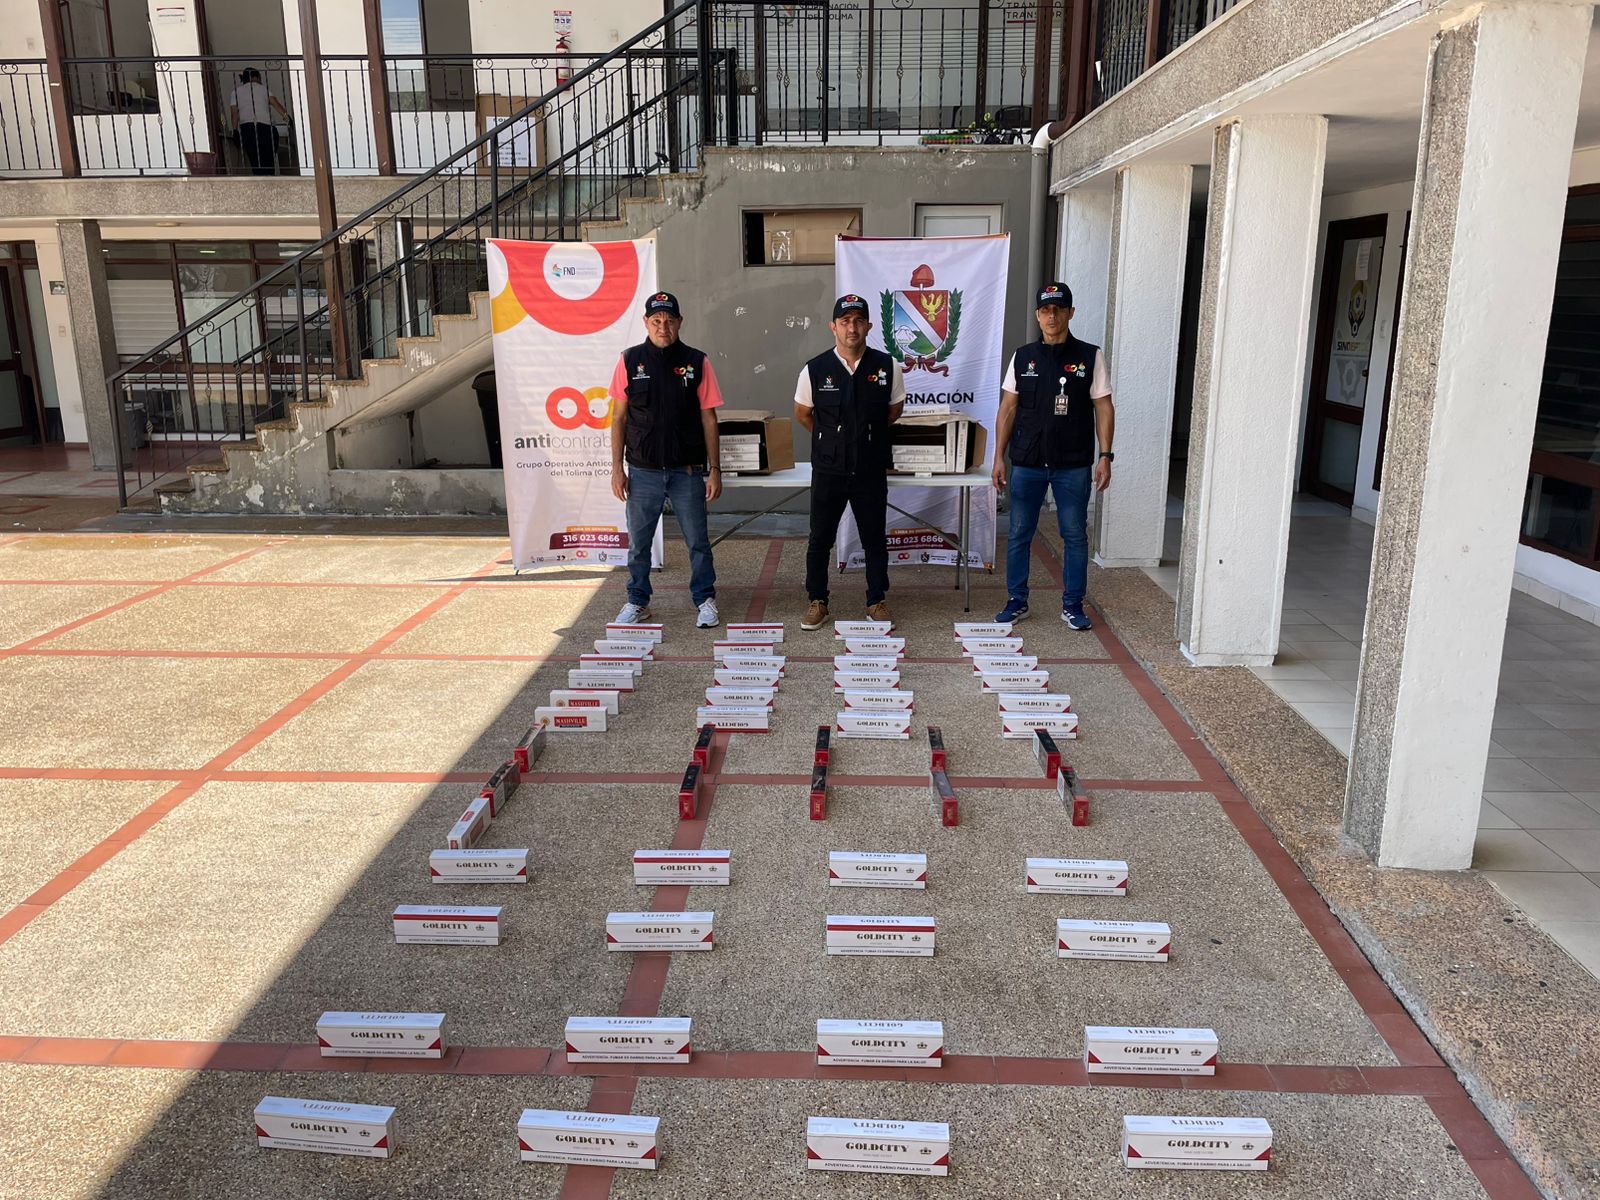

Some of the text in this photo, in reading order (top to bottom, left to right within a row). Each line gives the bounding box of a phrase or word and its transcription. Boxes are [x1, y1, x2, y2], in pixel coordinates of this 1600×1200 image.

[563, 267, 576, 276] FND
[904, 389, 974, 404] RNACIÓN
[514, 432, 612, 449] anticontrab
[594, 469, 612, 477] (GO
[562, 534, 578, 542] 316
[598, 534, 620, 542] 6866
[886, 536, 901, 545] 316
[920, 535, 944, 543] 6866
[350, 1032, 406, 1040] GOLDCITY
[600, 1036, 655, 1044] GOLDCITY
[852, 1040, 908, 1048] GOLDCITY
[1124, 1046, 1182, 1054] GOLDCITY
[290, 1122, 348, 1134] GOLDCITY
[555, 1134, 617, 1146] GOLDCITY
[1168, 1140, 1232, 1148] GOLDCITY
[846, 1142, 909, 1153] GOLDCITY
